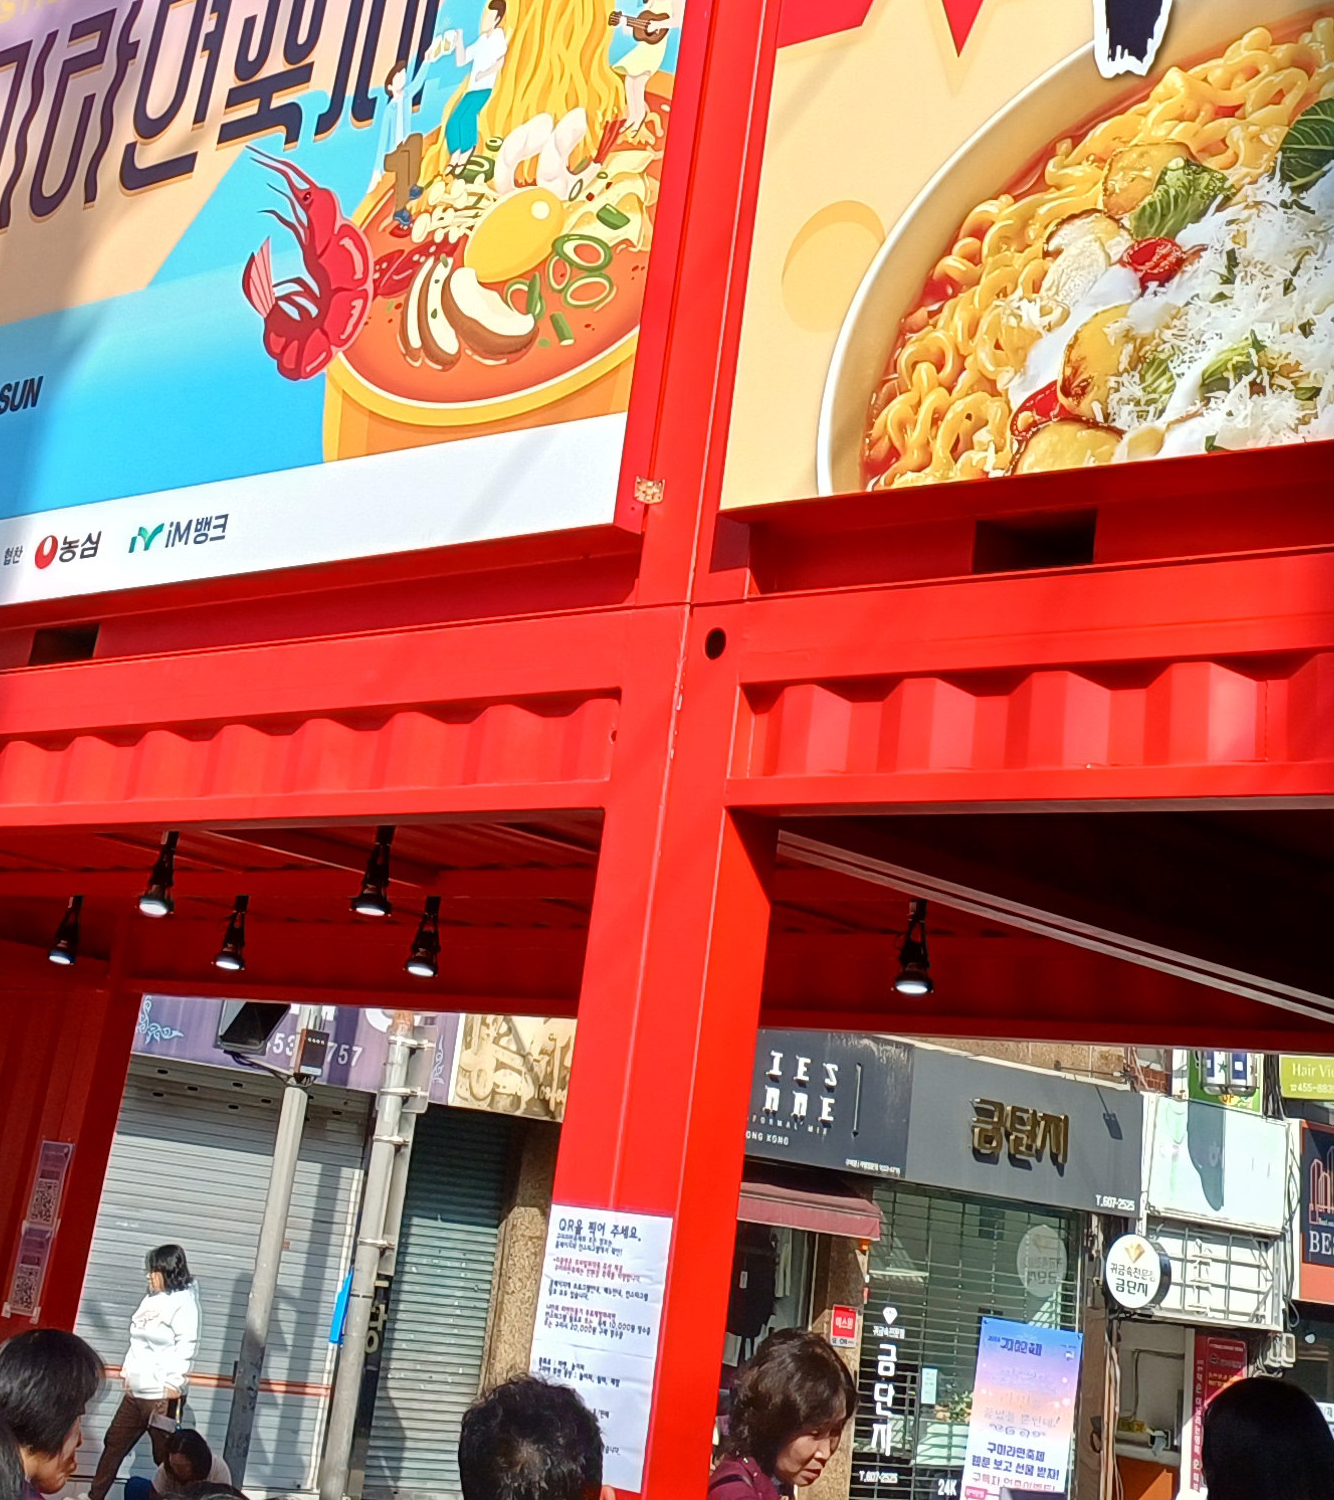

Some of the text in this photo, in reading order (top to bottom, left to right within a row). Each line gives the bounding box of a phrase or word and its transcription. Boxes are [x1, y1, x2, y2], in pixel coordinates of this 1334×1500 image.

[3, 546, 23, 566] 협찬
[58, 530, 102, 563] 농심
[1292, 1062, 1318, 1078] Hair
[766, 1132, 790, 1147] KONG
[971, 1098, 1070, 1168] 금단지
[559, 1217, 584, 1237] QR을
[588, 1220, 607, 1238] 찍어
[610, 1223, 642, 1243] 주세요.
[1115, 1277, 1149, 1298] 금단지
[871, 1343, 898, 1457] 금단지
[993, 1458, 1013, 1473] 보고
[938, 1478, 958, 1497] 24K
